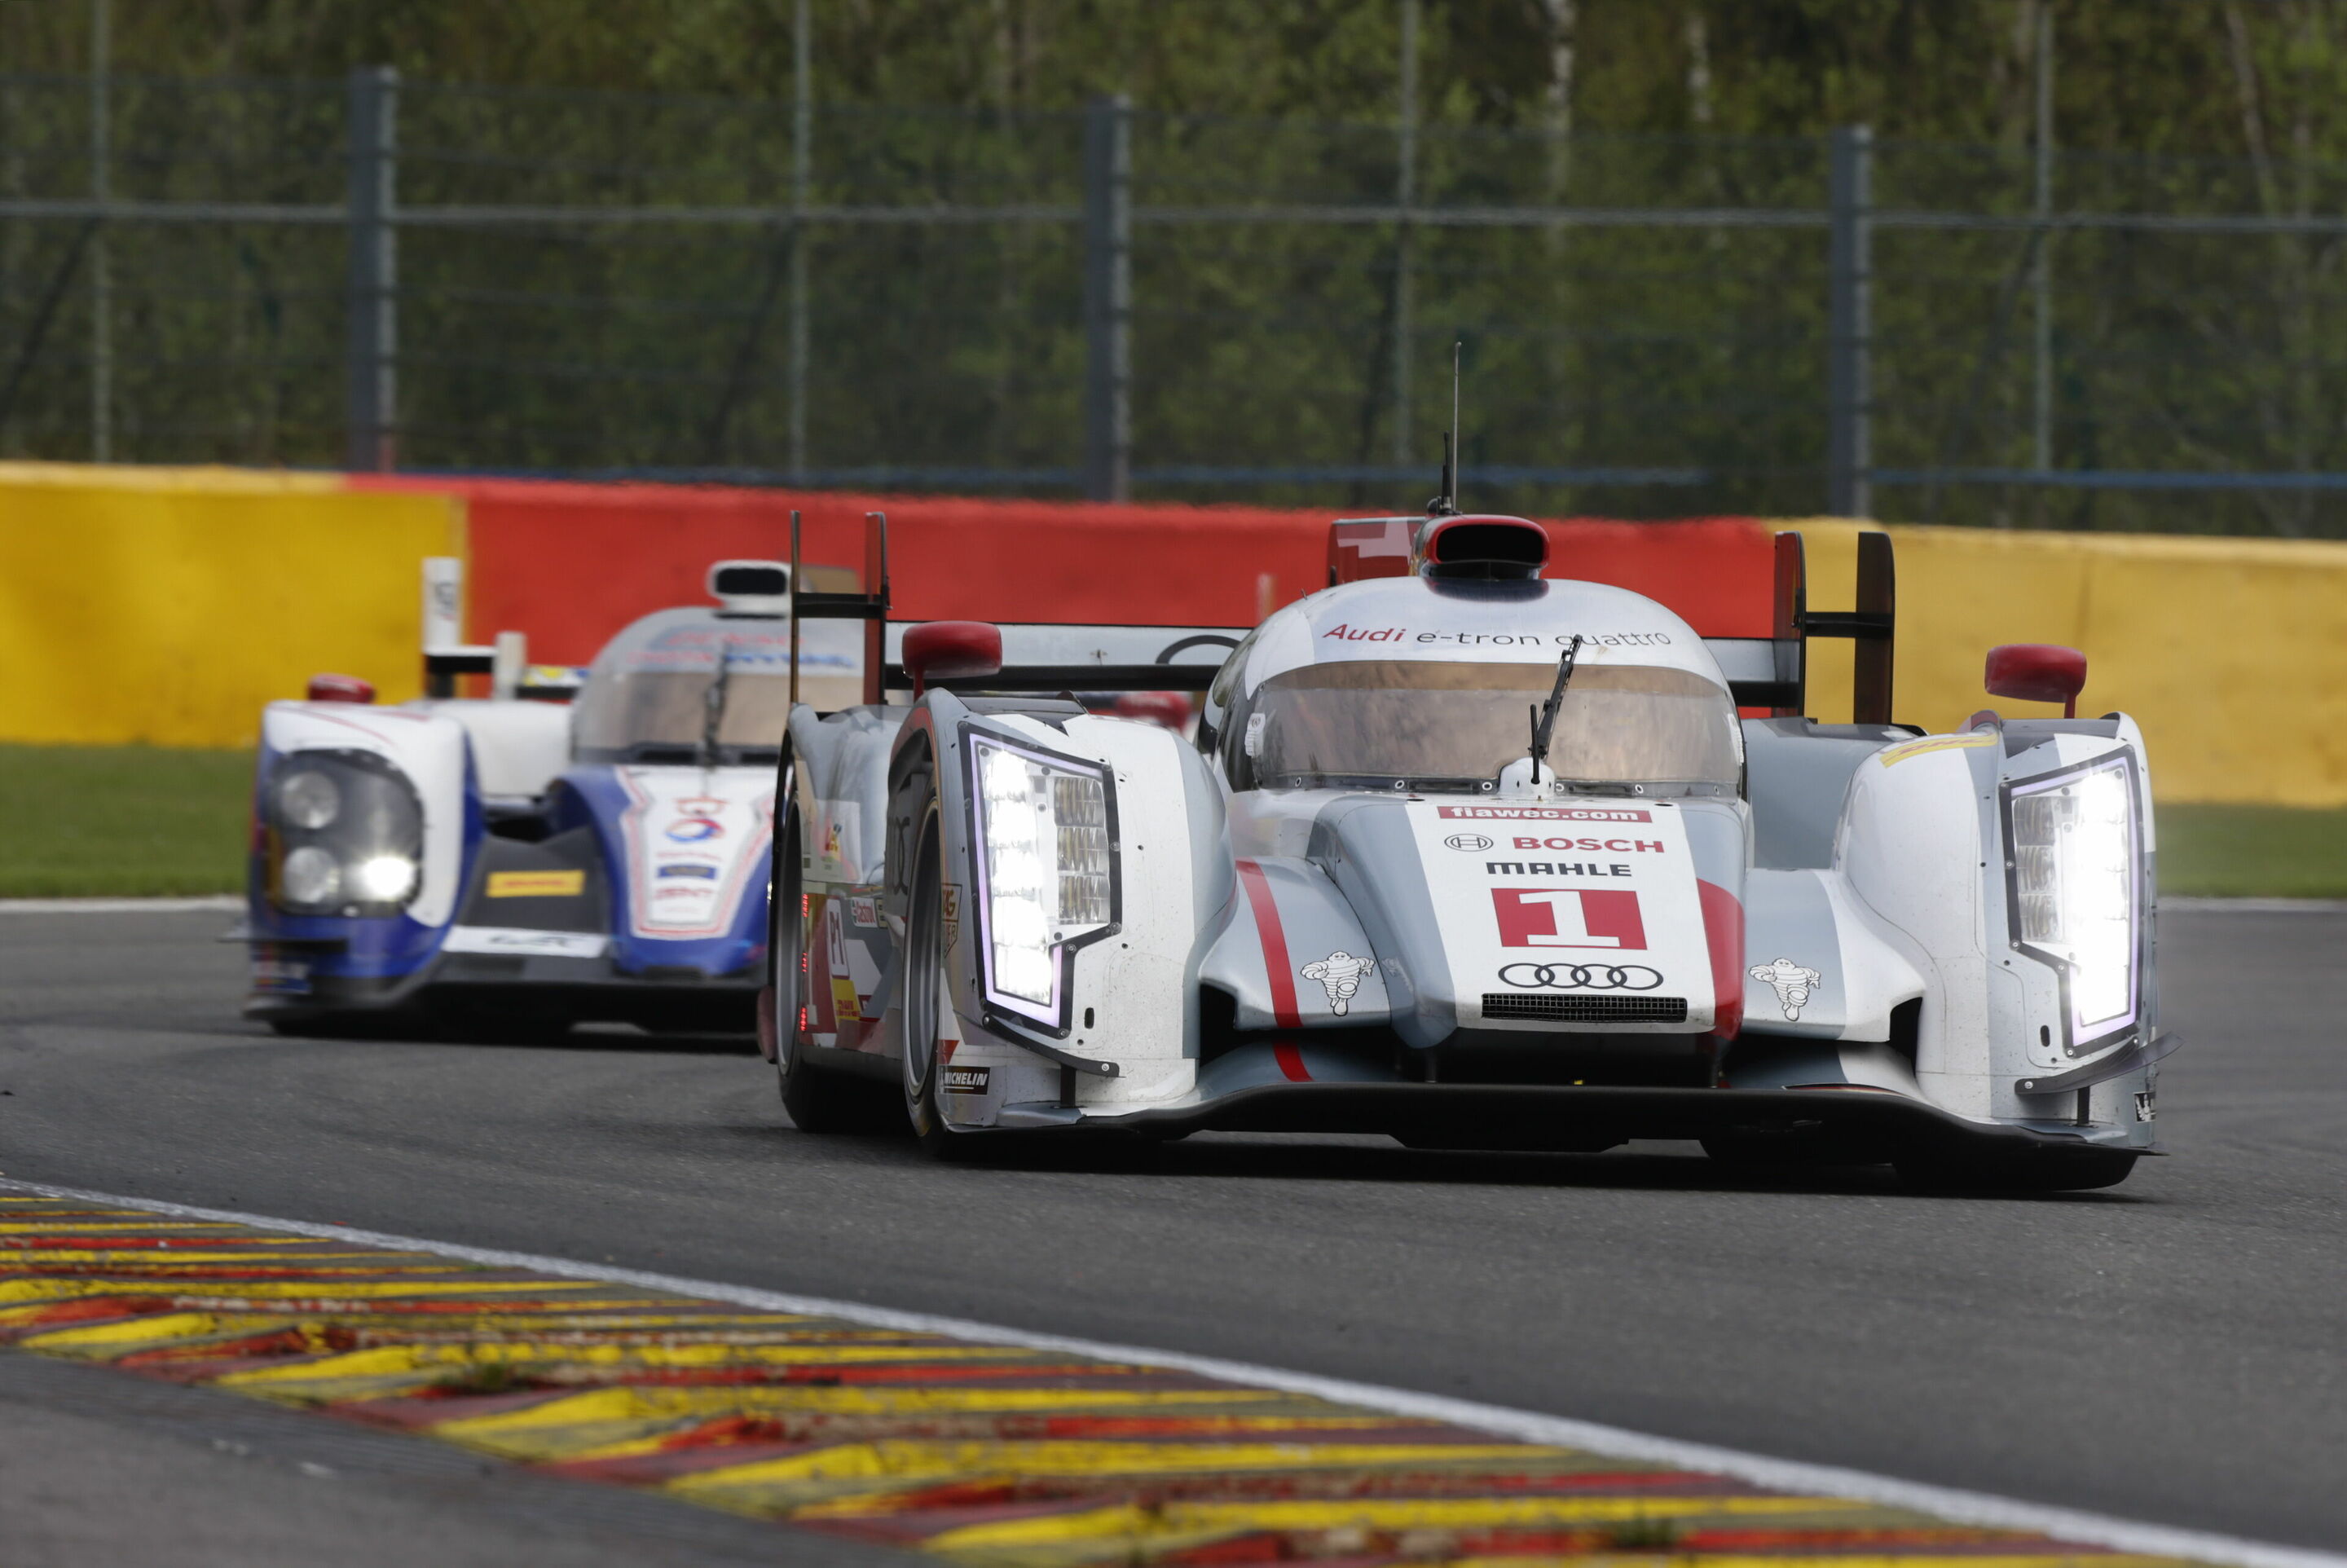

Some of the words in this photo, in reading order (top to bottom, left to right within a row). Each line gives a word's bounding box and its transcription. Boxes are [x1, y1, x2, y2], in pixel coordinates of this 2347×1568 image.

[1323, 623, 1407, 642] Audi
[1416, 631, 1541, 646] e-tron
[1555, 631, 1671, 650] quattro
[1451, 807, 1639, 820] fiawec.com
[1513, 837, 1665, 853] BOSCH
[1486, 862, 1632, 877] MAHLE
[1518, 891, 1620, 948] 1
[830, 911, 844, 965] P1
[944, 1072, 989, 1086] MICHELIN
